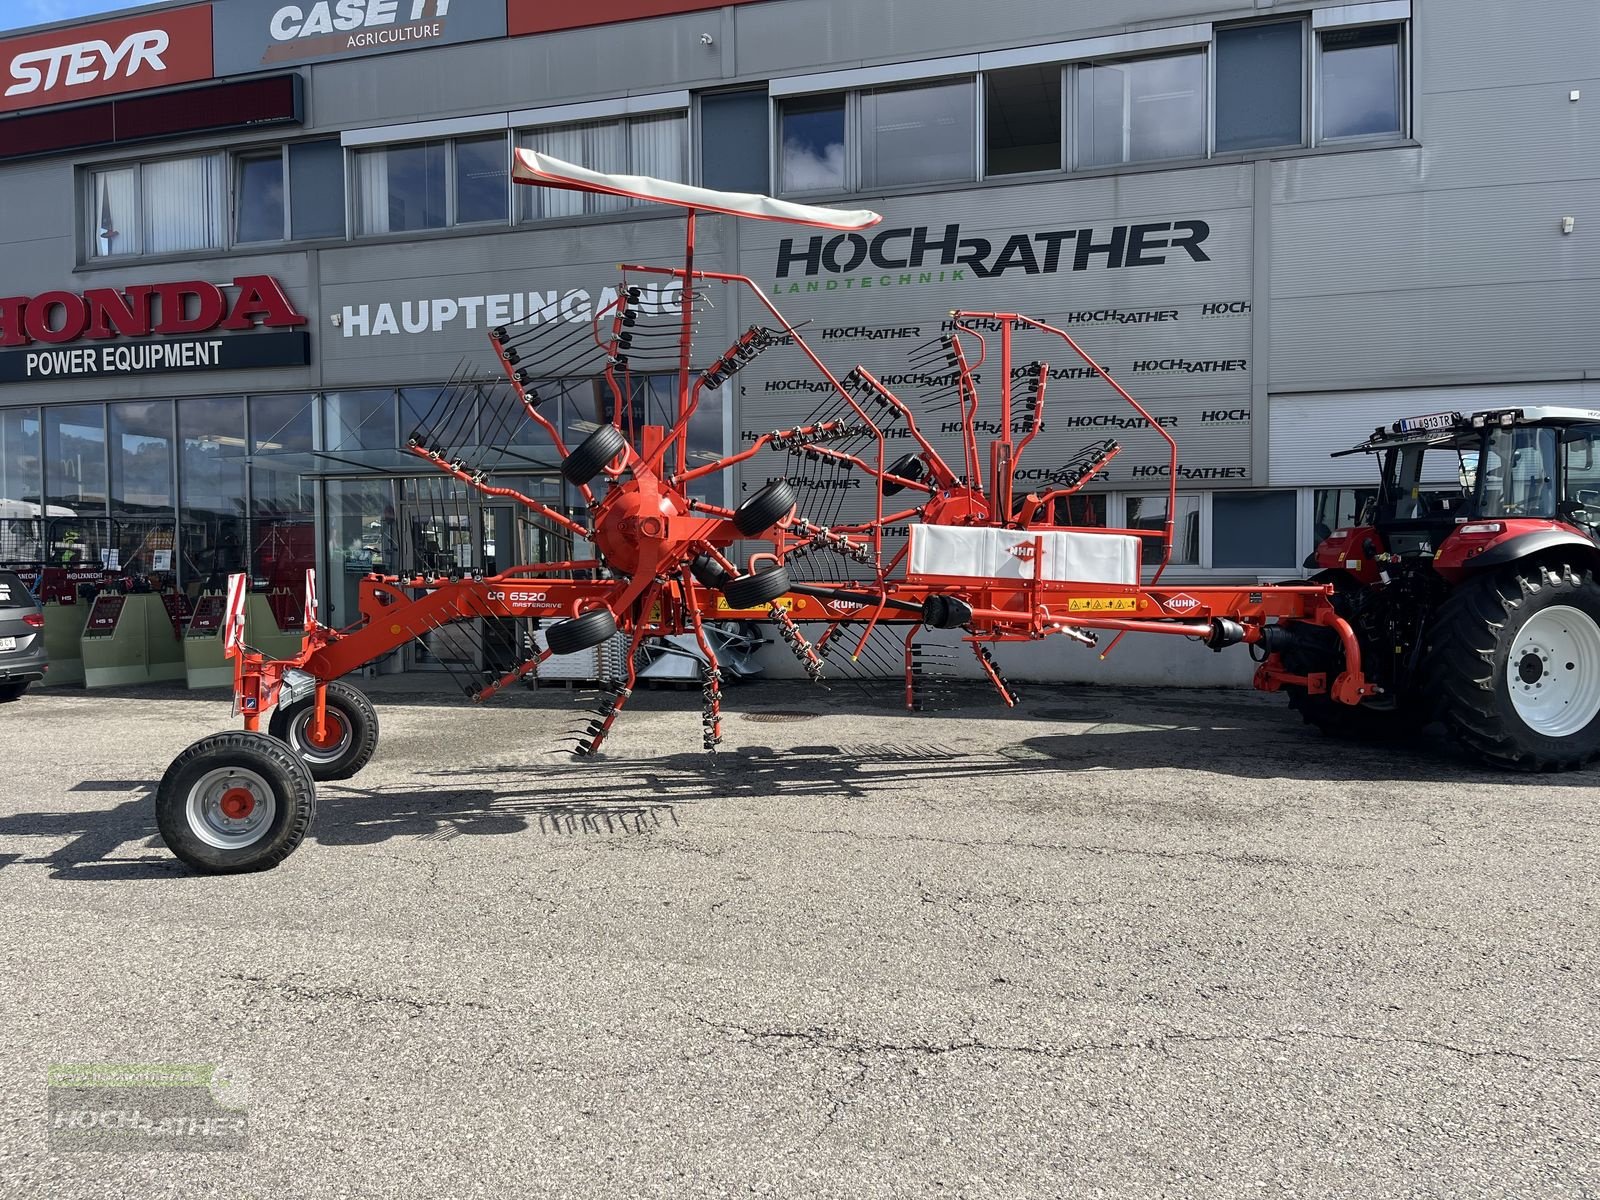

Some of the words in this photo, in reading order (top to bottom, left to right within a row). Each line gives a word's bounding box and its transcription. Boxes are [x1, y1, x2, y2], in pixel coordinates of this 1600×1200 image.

[270, 0, 399, 41] CASE
[347, 23, 440, 48] AGRICULTURE
[4, 29, 170, 98] STEYR
[775, 219, 1211, 279] HOCHRATHER
[772, 269, 965, 295] LANDTECHNIK
[1067, 309, 1179, 324] HOCHRATHER
[822, 326, 920, 340] HOCHRATHER
[26, 349, 97, 376] POWER
[102, 340, 223, 371] EQUIPMENT
[1132, 358, 1247, 373] HOCHRATHER
[880, 373, 982, 387] HOCHRATR
[1424, 417, 1438, 429] 913
[1439, 415, 1450, 426] TR
[509, 592, 547, 601] 6520
[833, 599, 863, 609] KUHN
[1169, 599, 1196, 608] KUHN
